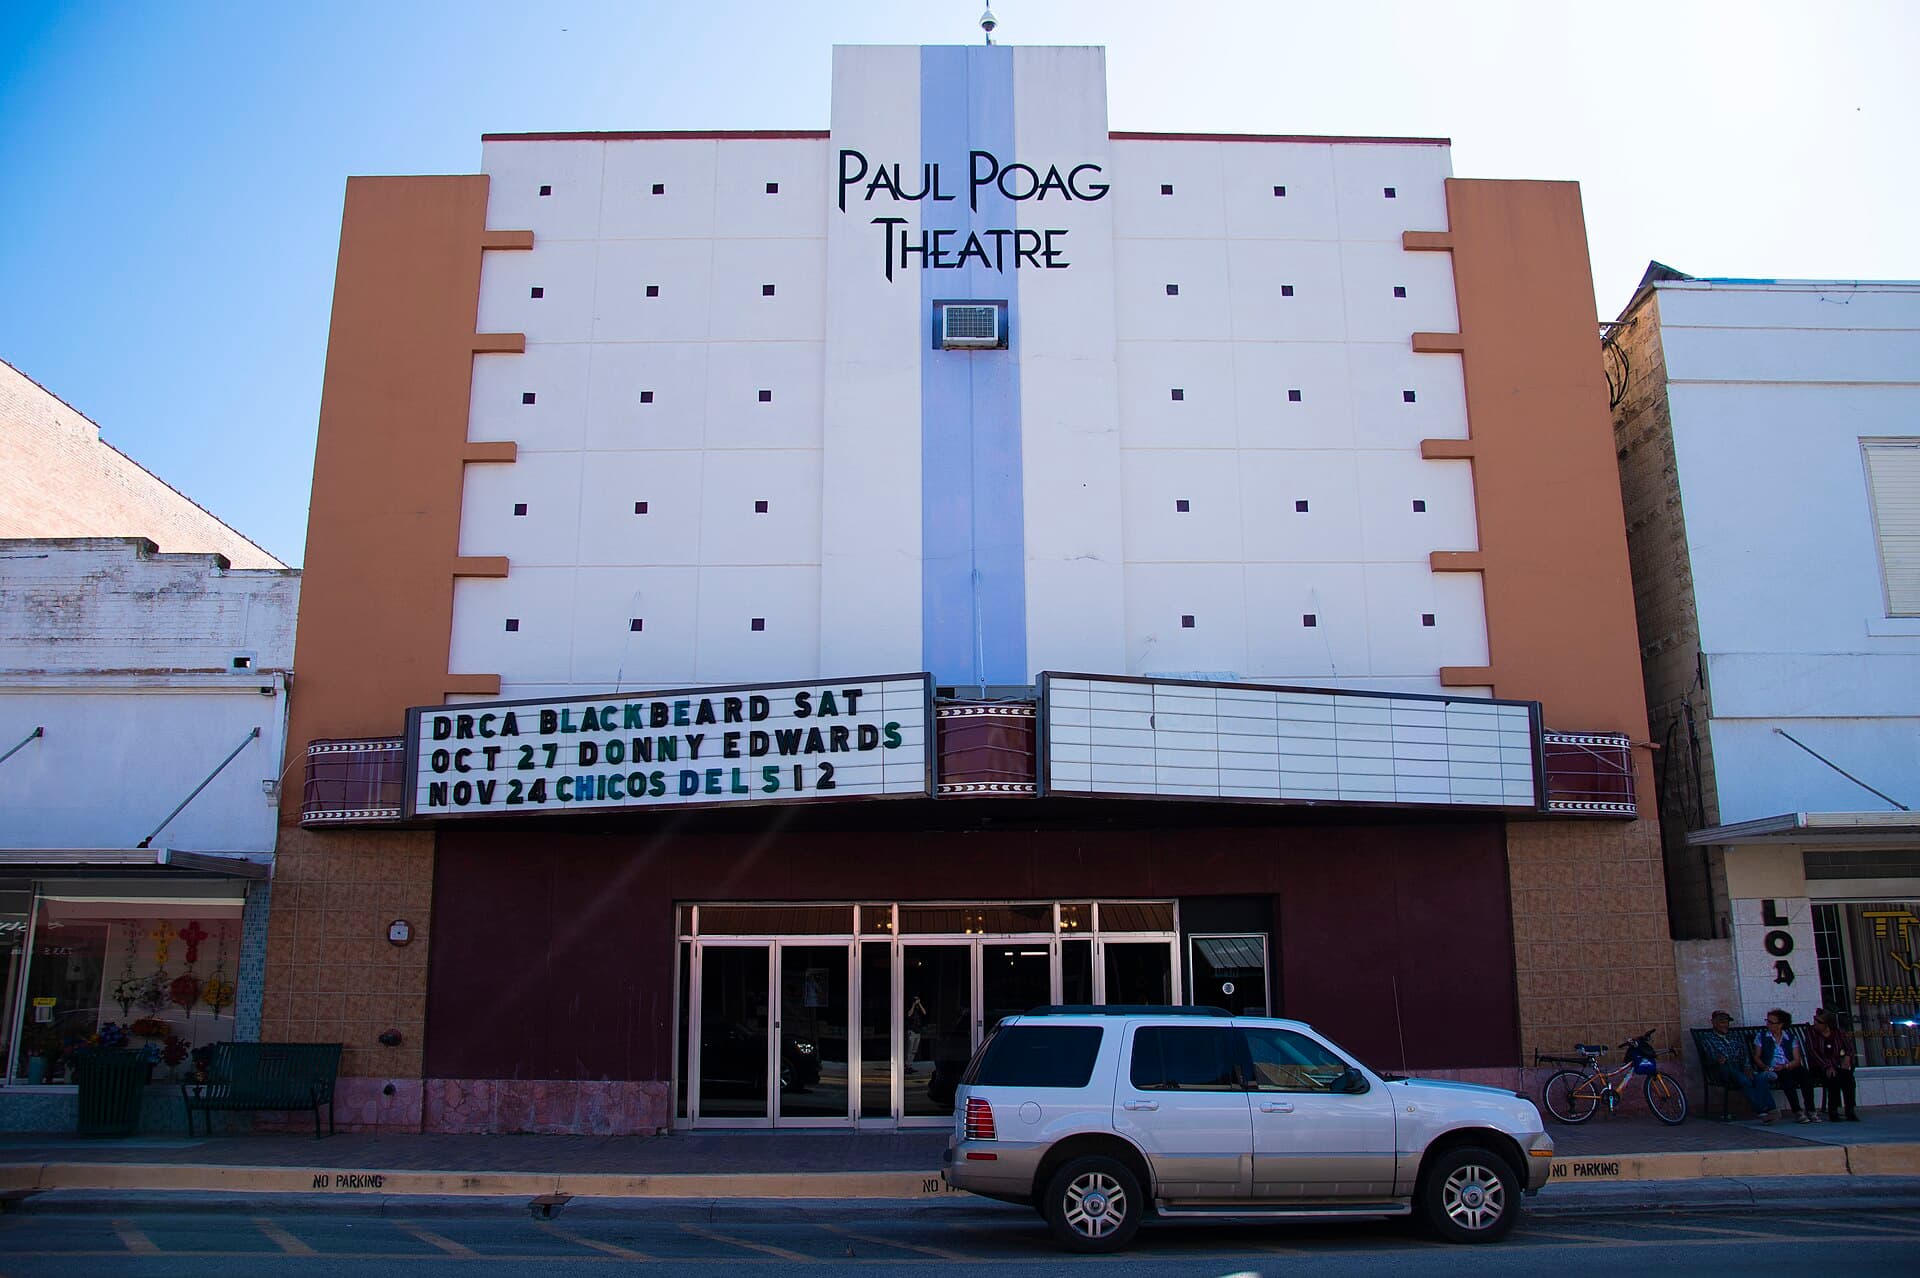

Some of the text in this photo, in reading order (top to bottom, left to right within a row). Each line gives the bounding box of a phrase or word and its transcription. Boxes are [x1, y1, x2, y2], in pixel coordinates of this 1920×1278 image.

[839, 149, 1110, 213] PAUL POAG
[870, 217, 1071, 283] THEATRE
[432, 688, 863, 740] DRCA BLACKBEARD SAT
[431, 721, 902, 773] OCT 27 DONNY EDWARDS
[429, 779, 497, 807] NOV
[506, 776, 547, 804] 24
[556, 770, 666, 803] CHICOS
[679, 767, 749, 796] DEL
[313, 1174, 383, 1189] NO PARKING
[922, 1179, 939, 1193] NO
[1552, 1162, 1619, 1177] NO PARKING
